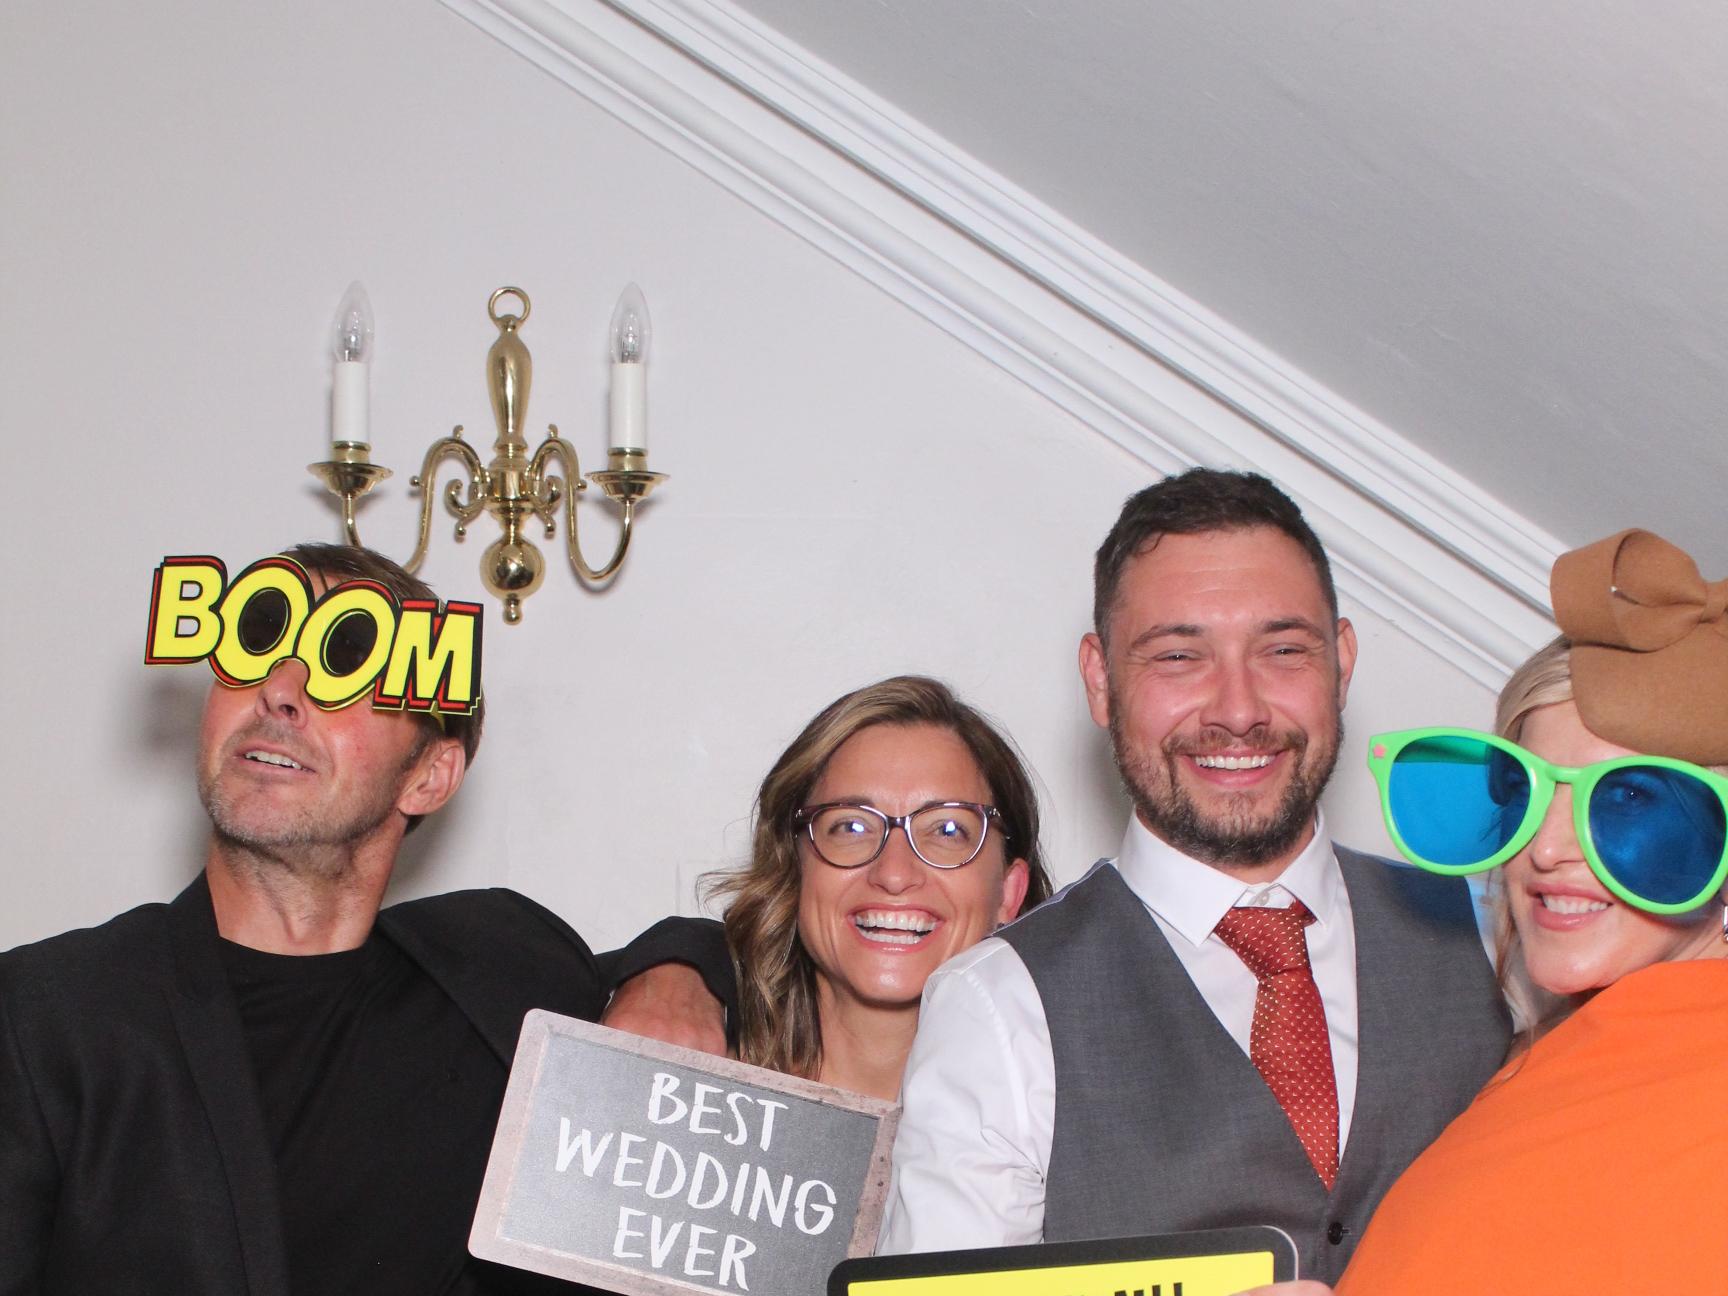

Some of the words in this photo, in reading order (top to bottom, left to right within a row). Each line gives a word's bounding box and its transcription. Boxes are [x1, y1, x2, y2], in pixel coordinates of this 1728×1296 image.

[145, 556, 483, 712] BOOM
[648, 1073, 788, 1152] BEST
[555, 1117, 837, 1235] WEDDING
[613, 1207, 756, 1291] EVER
